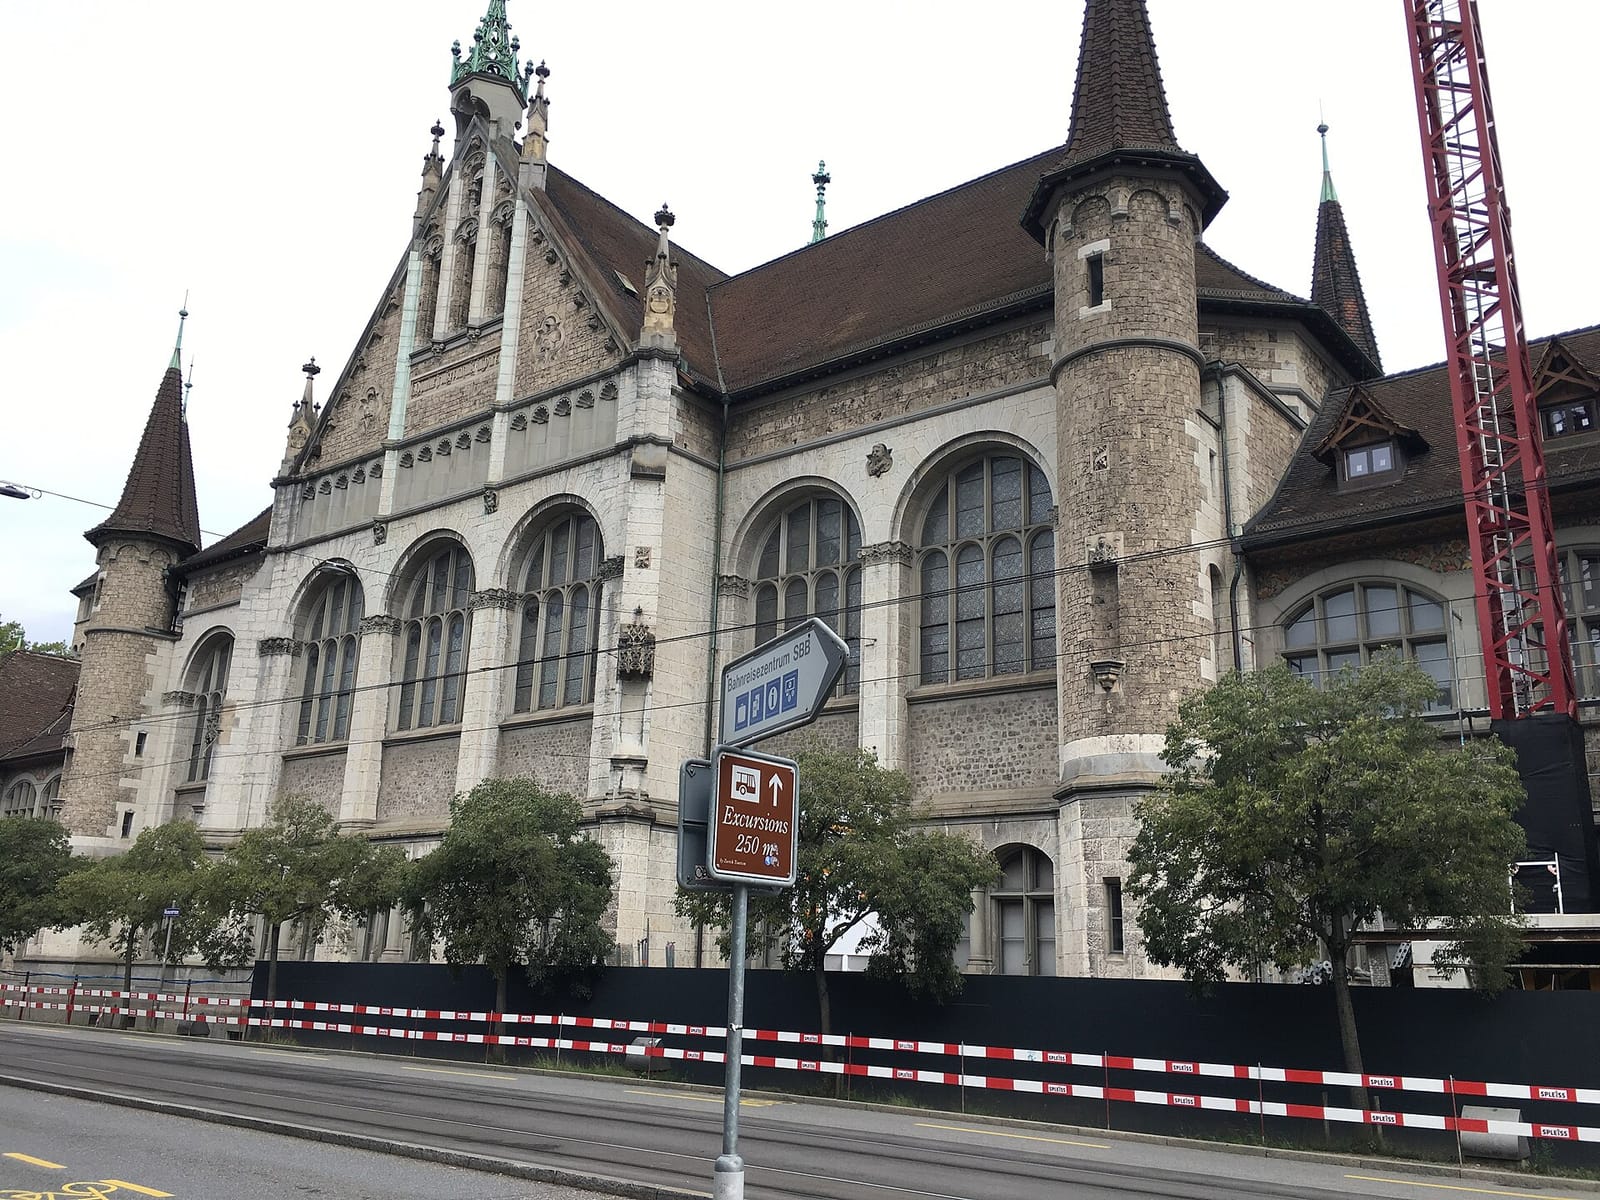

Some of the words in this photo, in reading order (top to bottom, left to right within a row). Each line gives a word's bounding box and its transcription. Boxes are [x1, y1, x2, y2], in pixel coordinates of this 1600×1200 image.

[727, 653, 790, 692] Bahnreisezentrum
[793, 639, 811, 661] SBB
[722, 805, 789, 834] Excursions
[735, 833, 760, 855] 250
